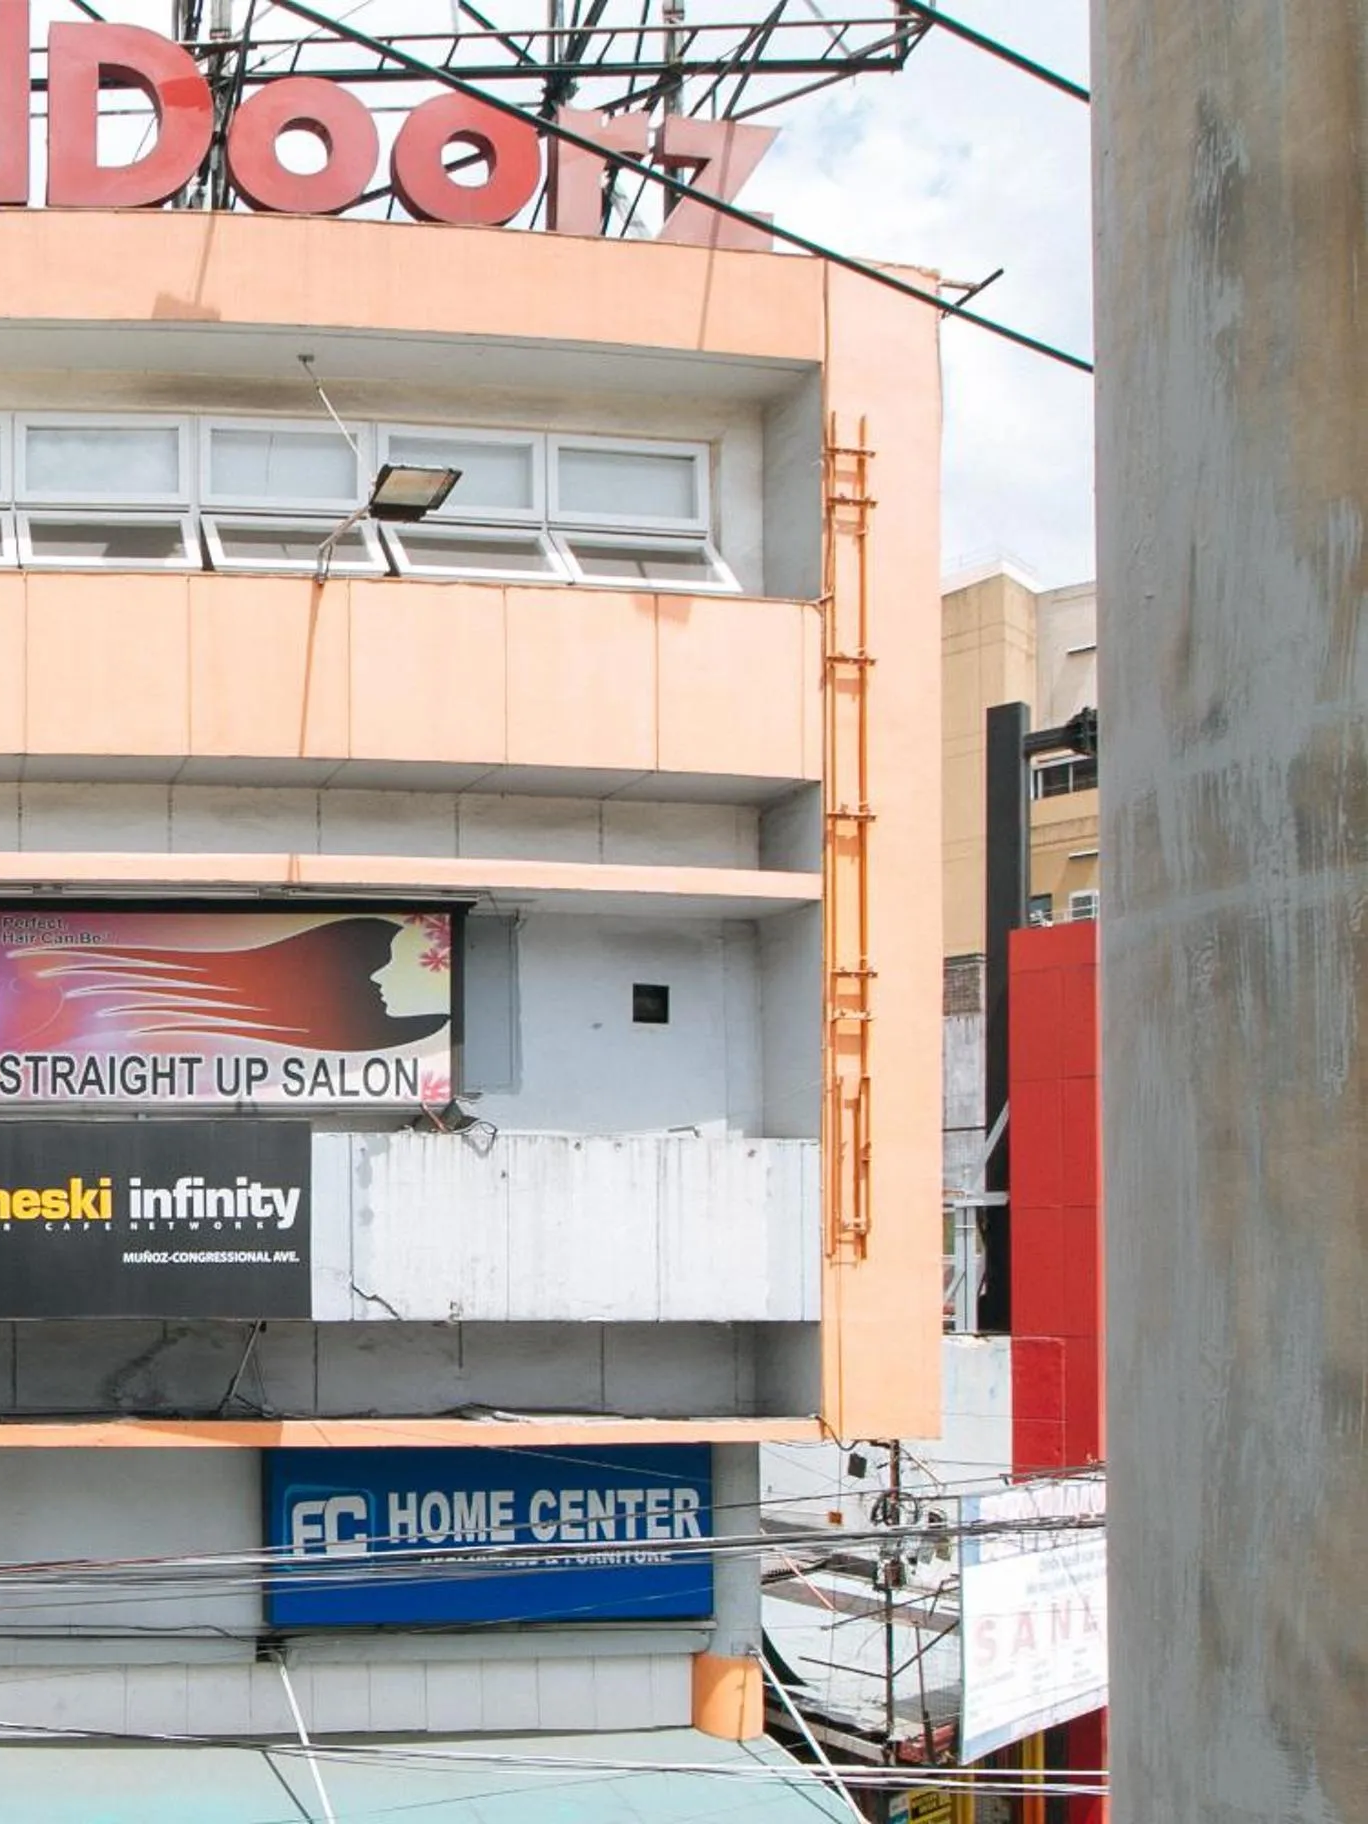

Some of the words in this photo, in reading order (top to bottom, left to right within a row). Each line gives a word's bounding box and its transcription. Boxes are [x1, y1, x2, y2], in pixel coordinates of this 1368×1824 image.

[2, 932, 35, 945] Hair
[41, 932, 75, 945] Can
[217, 1056, 269, 1097] UP
[282, 1056, 419, 1098] SALON
[129, 1176, 301, 1230] infinity
[44, 1222, 113, 1232] CAFE
[129, 1221, 265, 1232] NETWORK
[123, 1249, 270, 1264] MUÑOZ-CONGRESSIONAL
[273, 1251, 300, 1264] AVE.
[387, 1489, 516, 1544] HOME
[529, 1487, 702, 1542] CENTER
